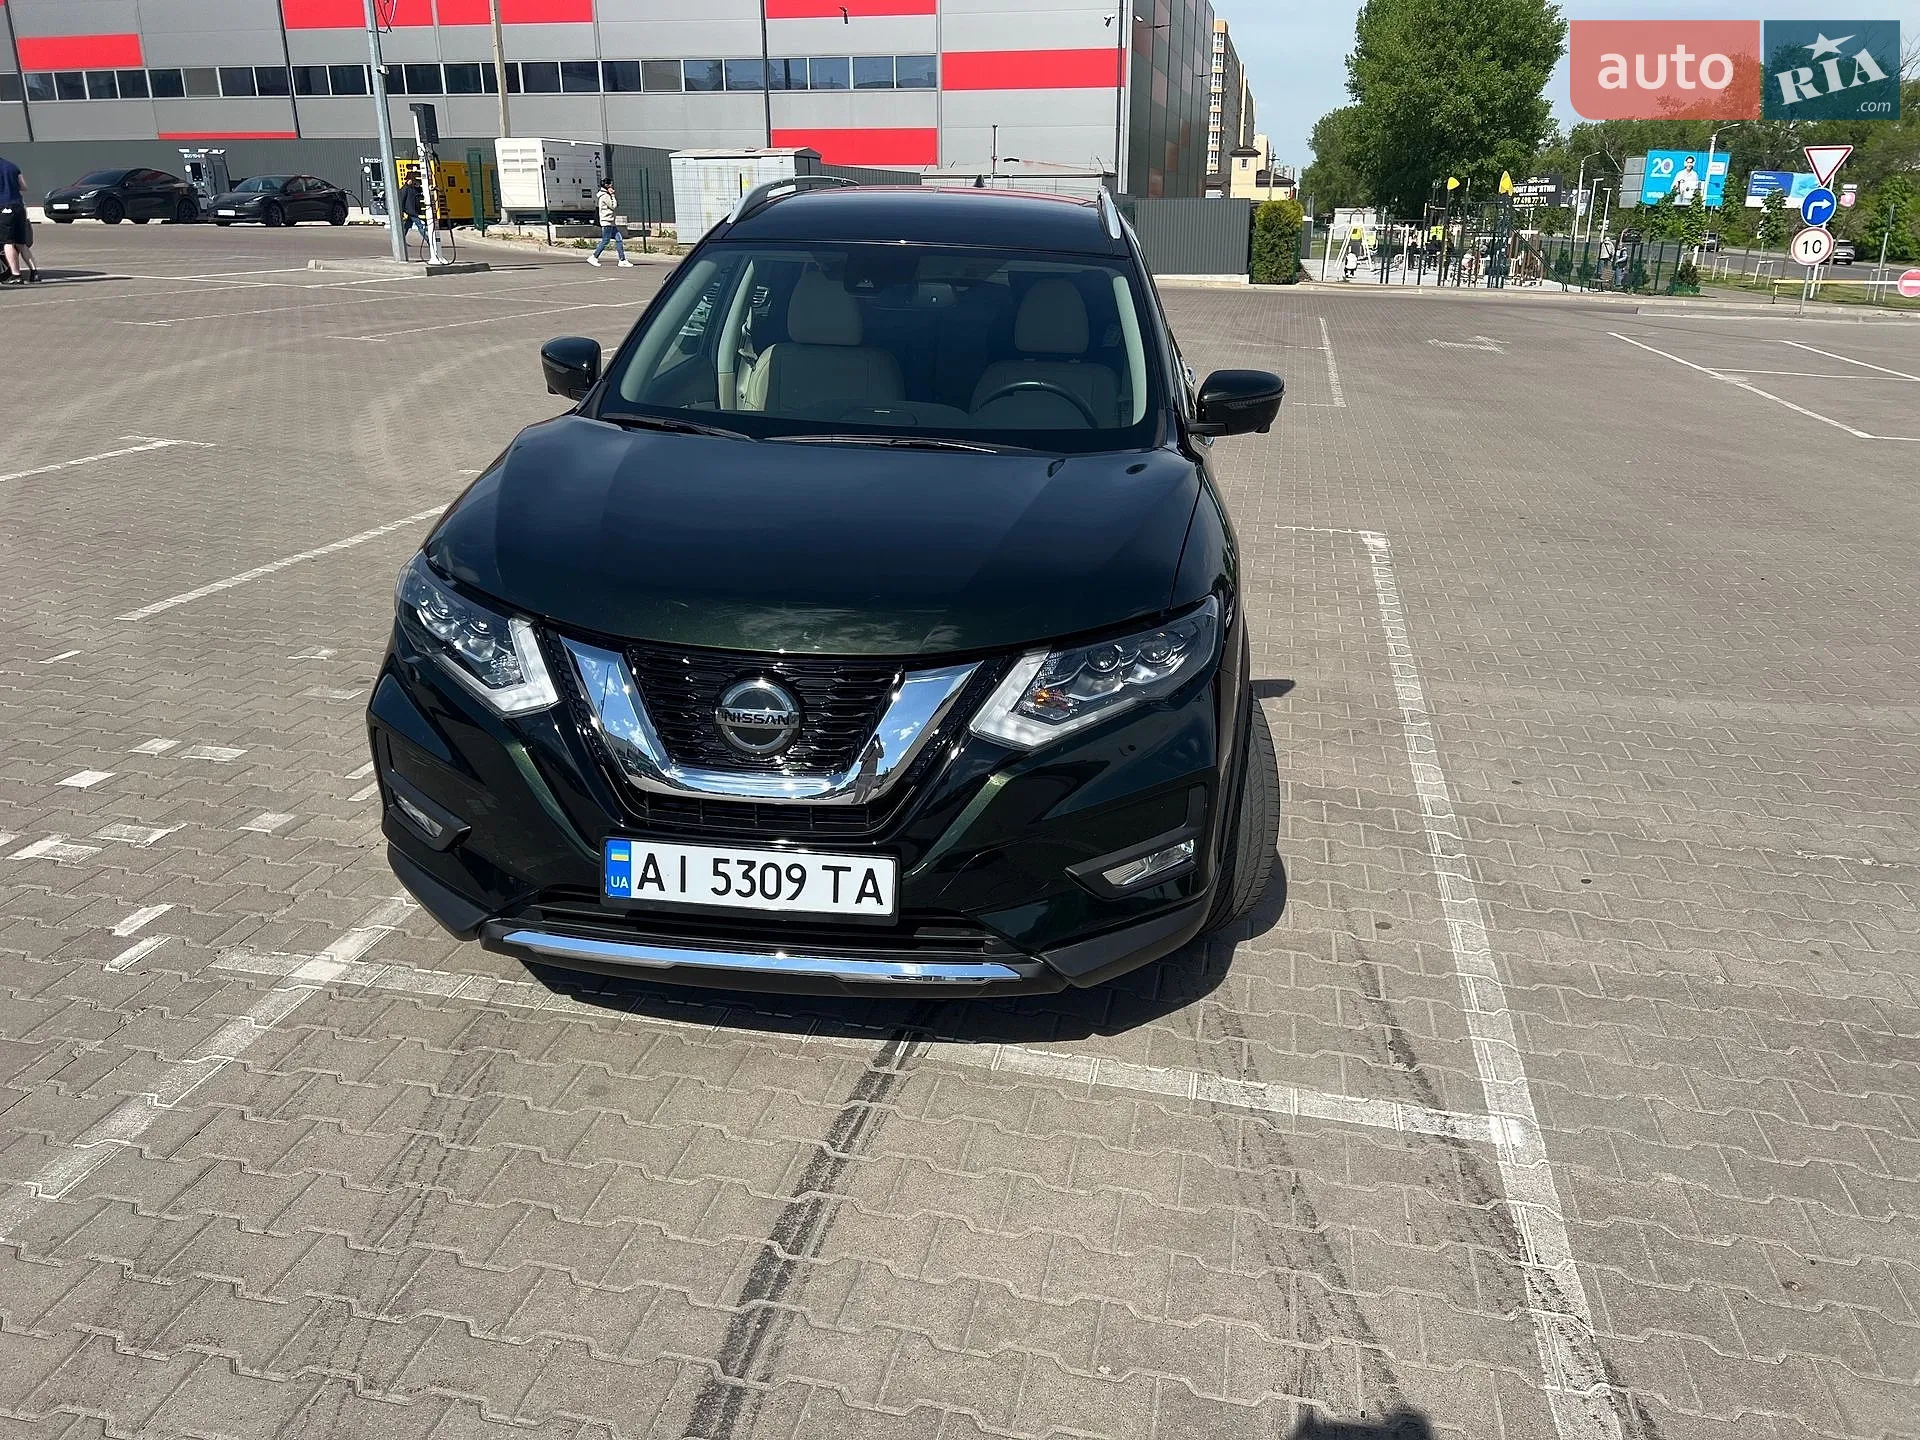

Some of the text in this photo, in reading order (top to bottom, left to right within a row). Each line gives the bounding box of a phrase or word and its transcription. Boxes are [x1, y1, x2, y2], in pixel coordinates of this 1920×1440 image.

[1650, 157, 1674, 178] 20
[1802, 239, 1822, 255] 10
[724, 710, 790, 726] NISSAN
[611, 876, 629, 889] UA
[637, 853, 884, 906] AI 5309 TA
